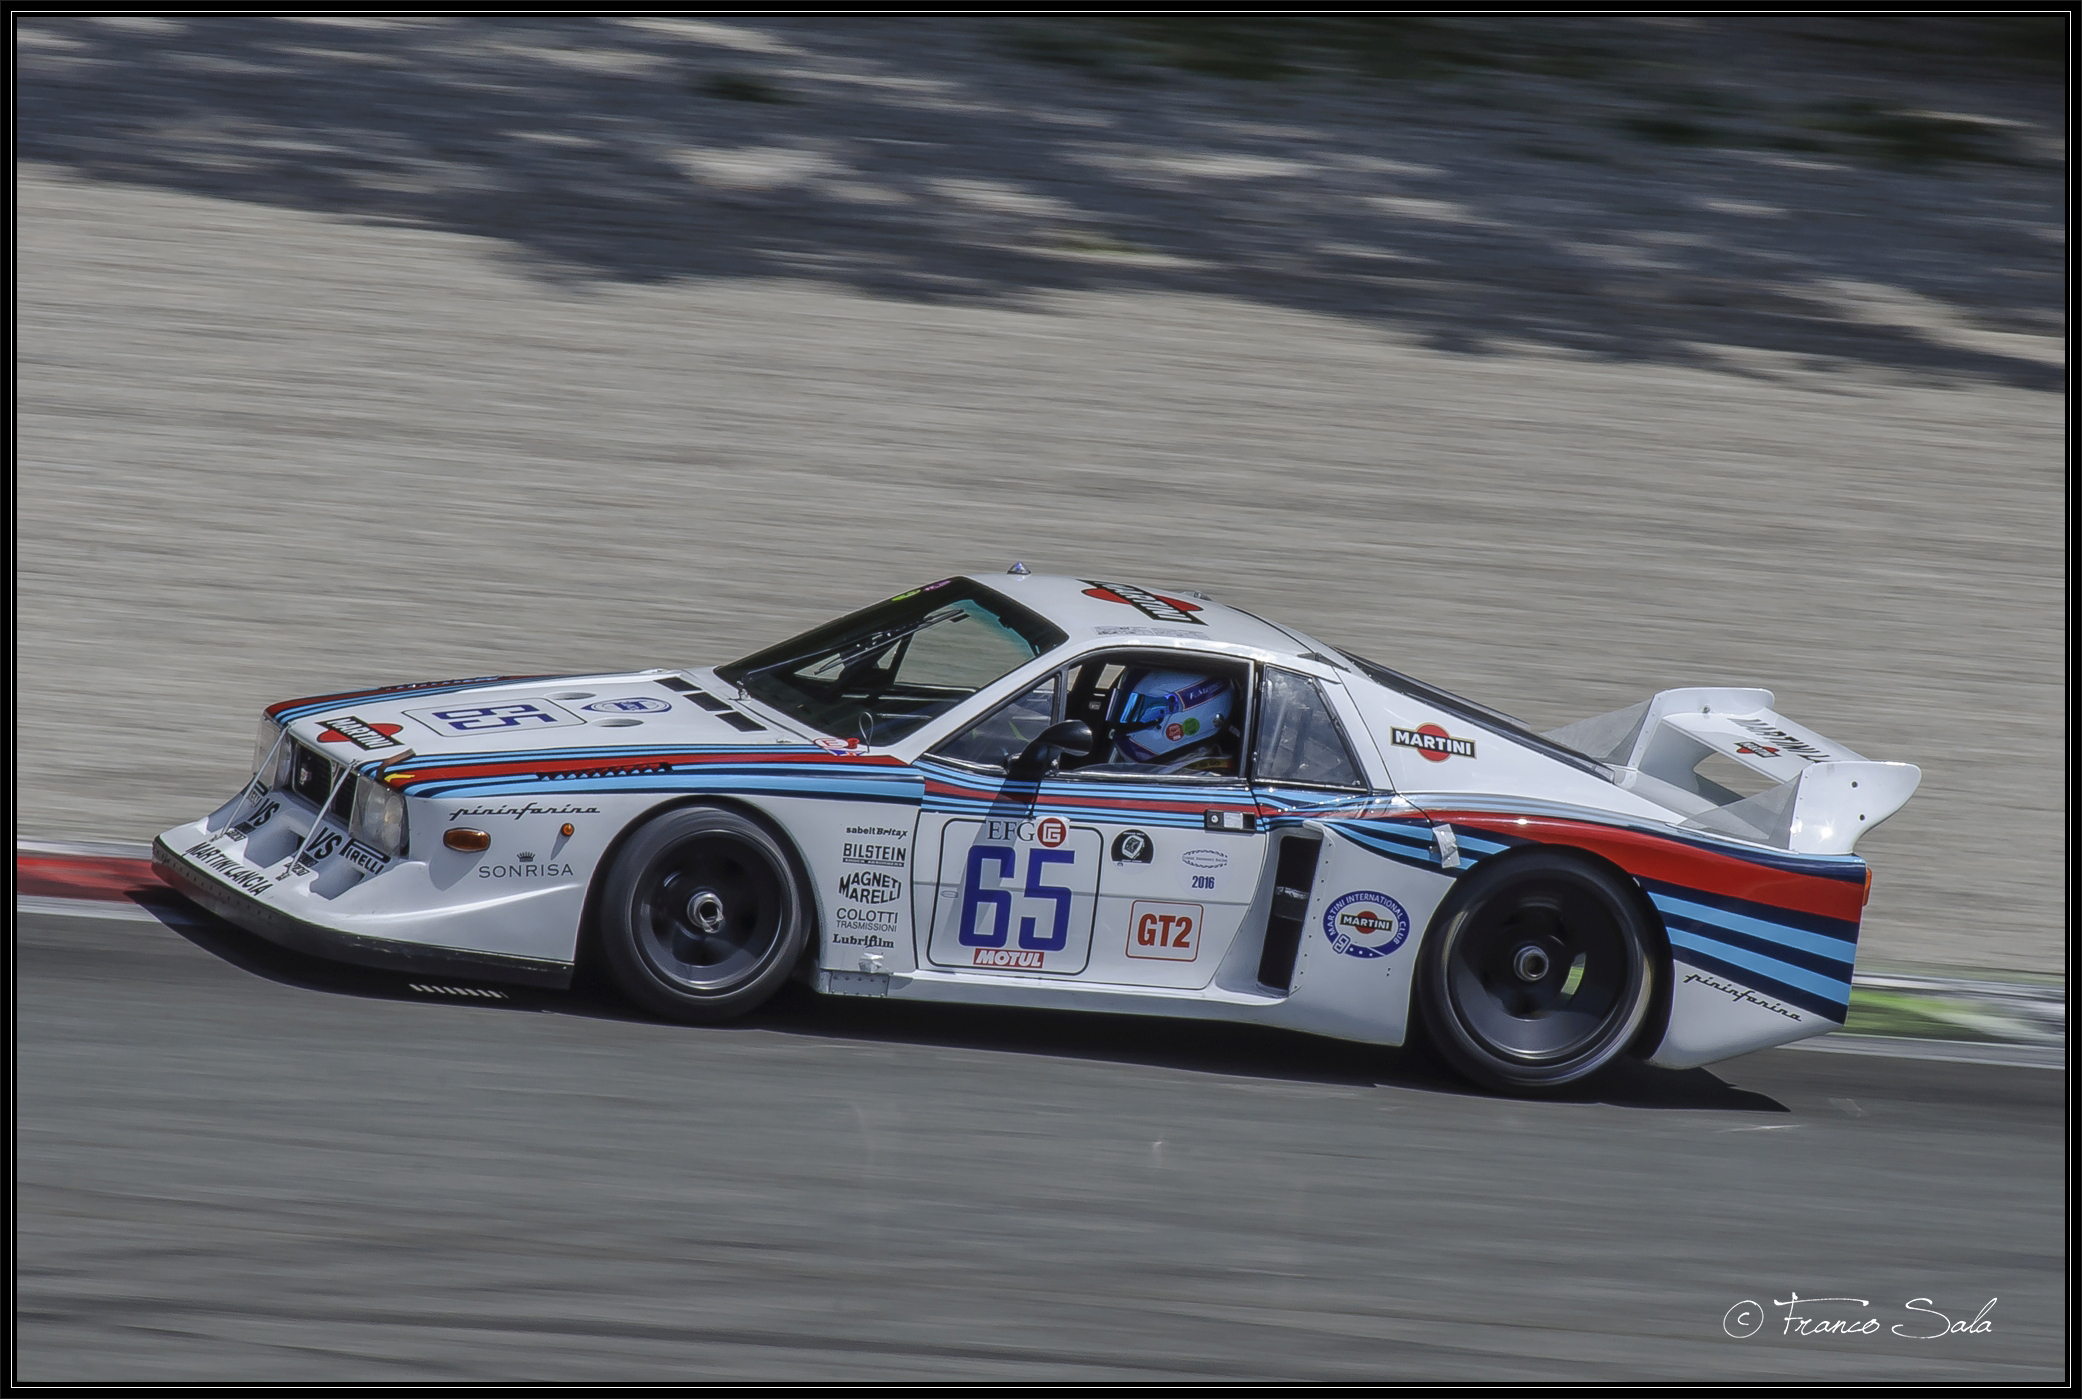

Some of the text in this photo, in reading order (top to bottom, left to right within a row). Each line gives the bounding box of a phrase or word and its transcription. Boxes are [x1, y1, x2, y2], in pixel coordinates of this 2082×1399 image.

[432, 704, 558, 731] 65
[326, 718, 394, 748] MARTINI
[1395, 730, 1472, 756] MARTINI
[1726, 717, 1822, 753] MARTINI
[247, 798, 281, 827] VS
[449, 802, 600, 821] pininfarina
[306, 827, 343, 860] VS
[846, 826, 908, 840] sabelt Britax
[987, 820, 1036, 842] EFG
[339, 838, 392, 875] PIRELLI
[843, 842, 907, 862] BILSTEIN
[185, 842, 244, 874] MARTINI
[223, 866, 274, 896] LANCIA
[478, 863, 574, 878] SONRISA
[1191, 875, 1215, 889] 2016
[958, 844, 1076, 952] 65
[836, 907, 899, 924] COLOTTI
[836, 919, 898, 932] TRASMISSIONI
[1327, 893, 1407, 945] MARTINI INTERNATIONAL CLUB
[1343, 916, 1390, 930] MARTINI
[832, 933, 894, 948] Lubrifilm
[1137, 913, 1193, 948] GT2
[975, 949, 1042, 967] MOTUL
[1683, 974, 1802, 1022] pininfarina
